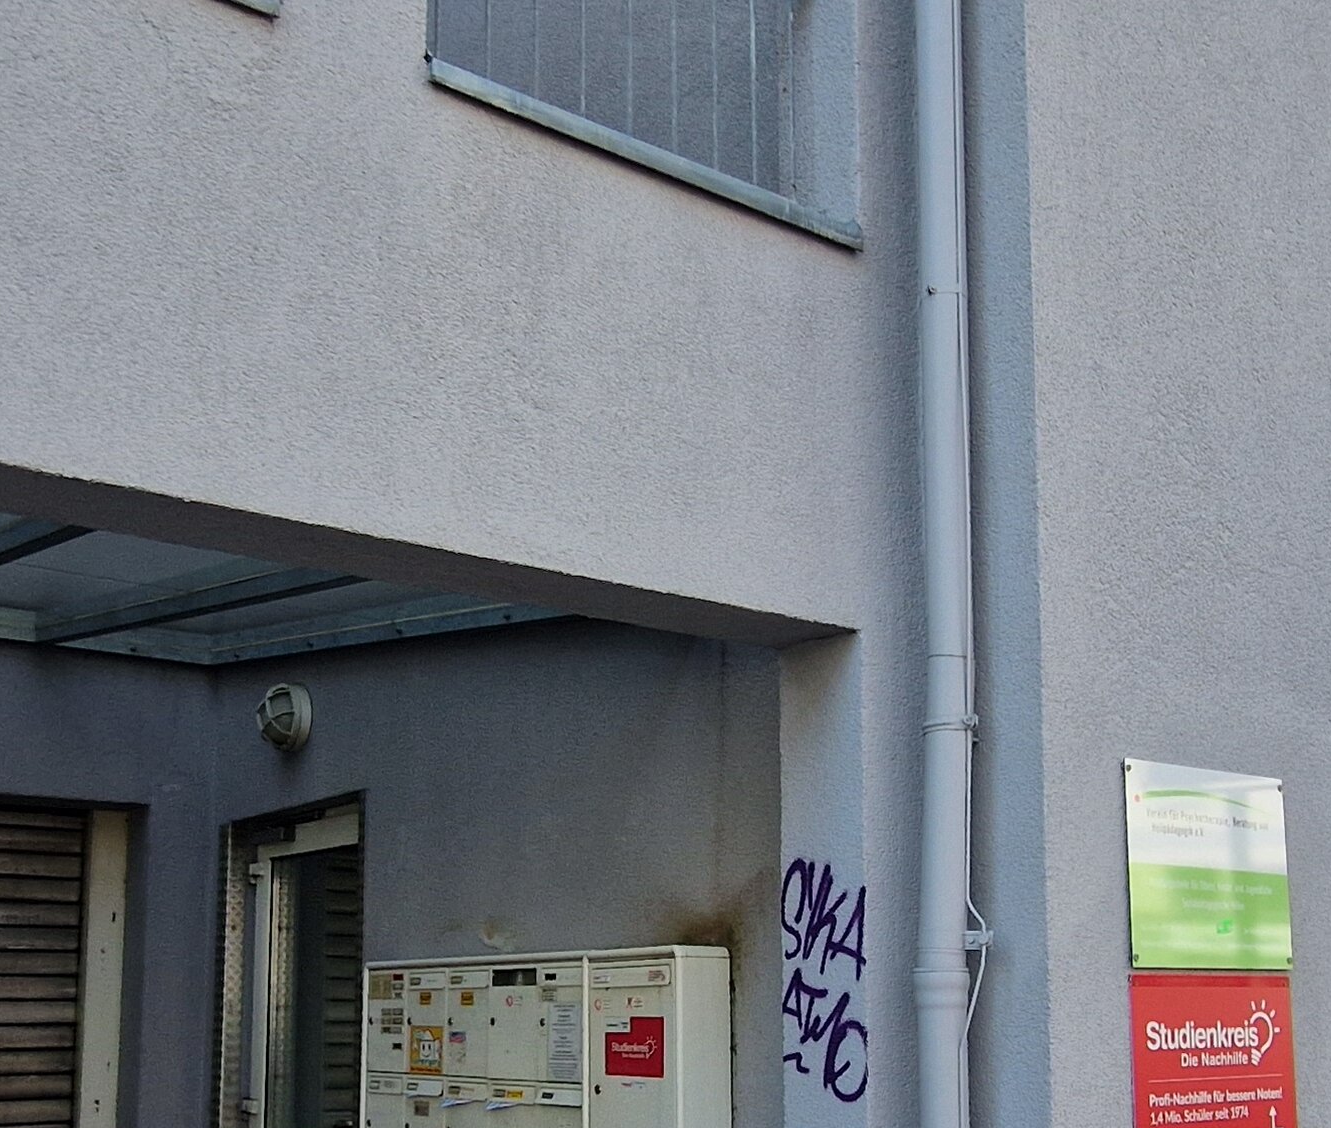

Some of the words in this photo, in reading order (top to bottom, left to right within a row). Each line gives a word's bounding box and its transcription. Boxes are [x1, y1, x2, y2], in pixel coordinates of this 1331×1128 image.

[1146, 1020, 1259, 1051] Studienkreis
[1180, 1053, 1199, 1068] Die
[1201, 1050, 1248, 1067] Nachhilfe
[1149, 1091, 1212, 1108] Profi-Nachhilfe
[1212, 1089, 1225, 1104] für
[1226, 1088, 1255, 1102] bessere
[1257, 1086, 1283, 1101] Noten!
[1150, 1110, 1164, 1126] 1,4
[1165, 1109, 1182, 1124] Mio.
[1183, 1107, 1214, 1122] Schüler
[1215, 1107, 1229, 1121] seit
[1230, 1105, 1250, 1119] 1974
